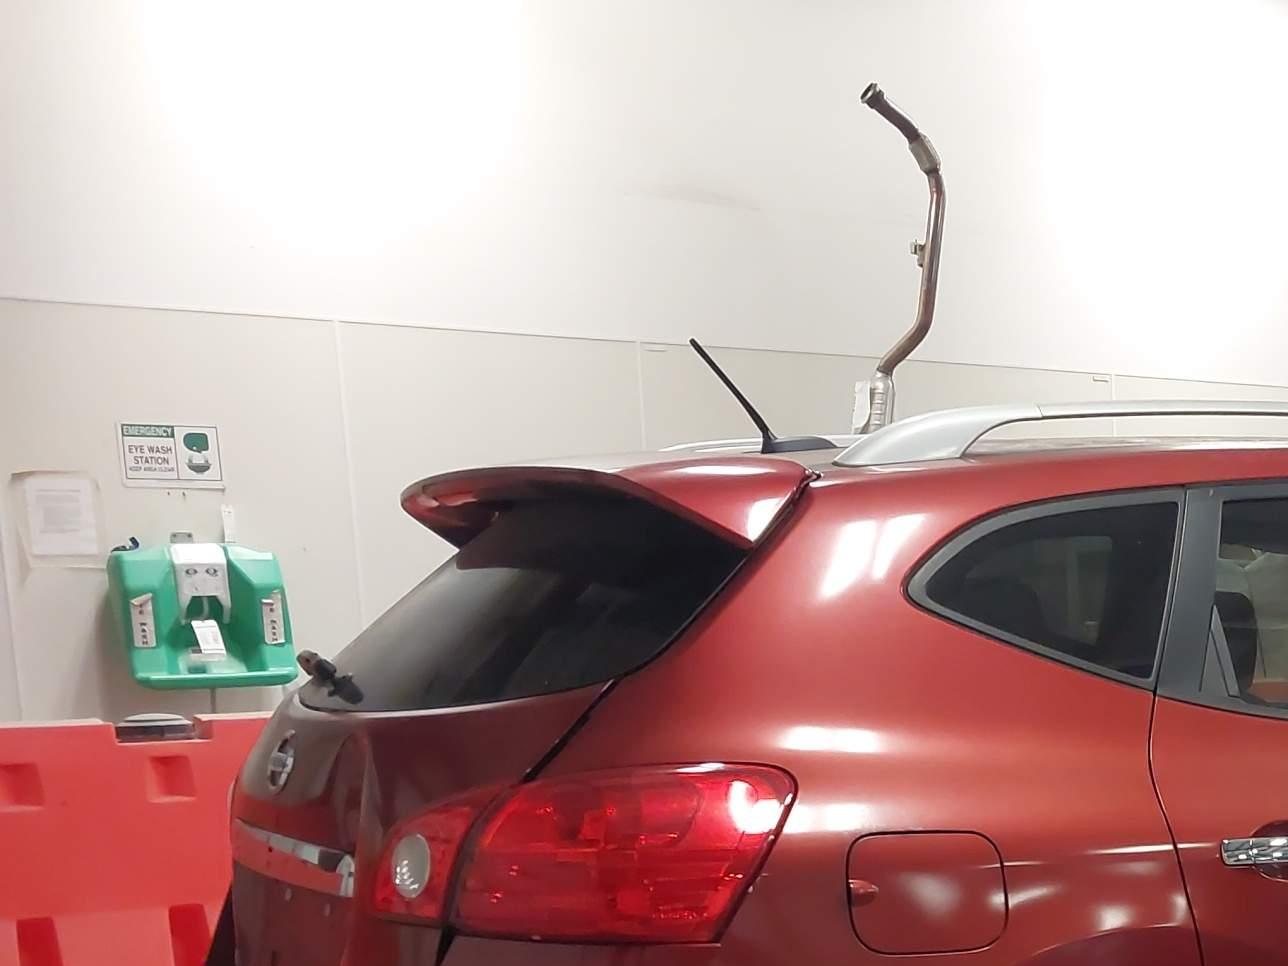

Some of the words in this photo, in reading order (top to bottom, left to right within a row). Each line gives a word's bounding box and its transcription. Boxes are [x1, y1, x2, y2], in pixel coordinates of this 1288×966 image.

[123, 425, 173, 437] EMERGENCY
[127, 444, 145, 454] EYE
[147, 445, 173, 455] WASH
[133, 455, 170, 466] STATION
